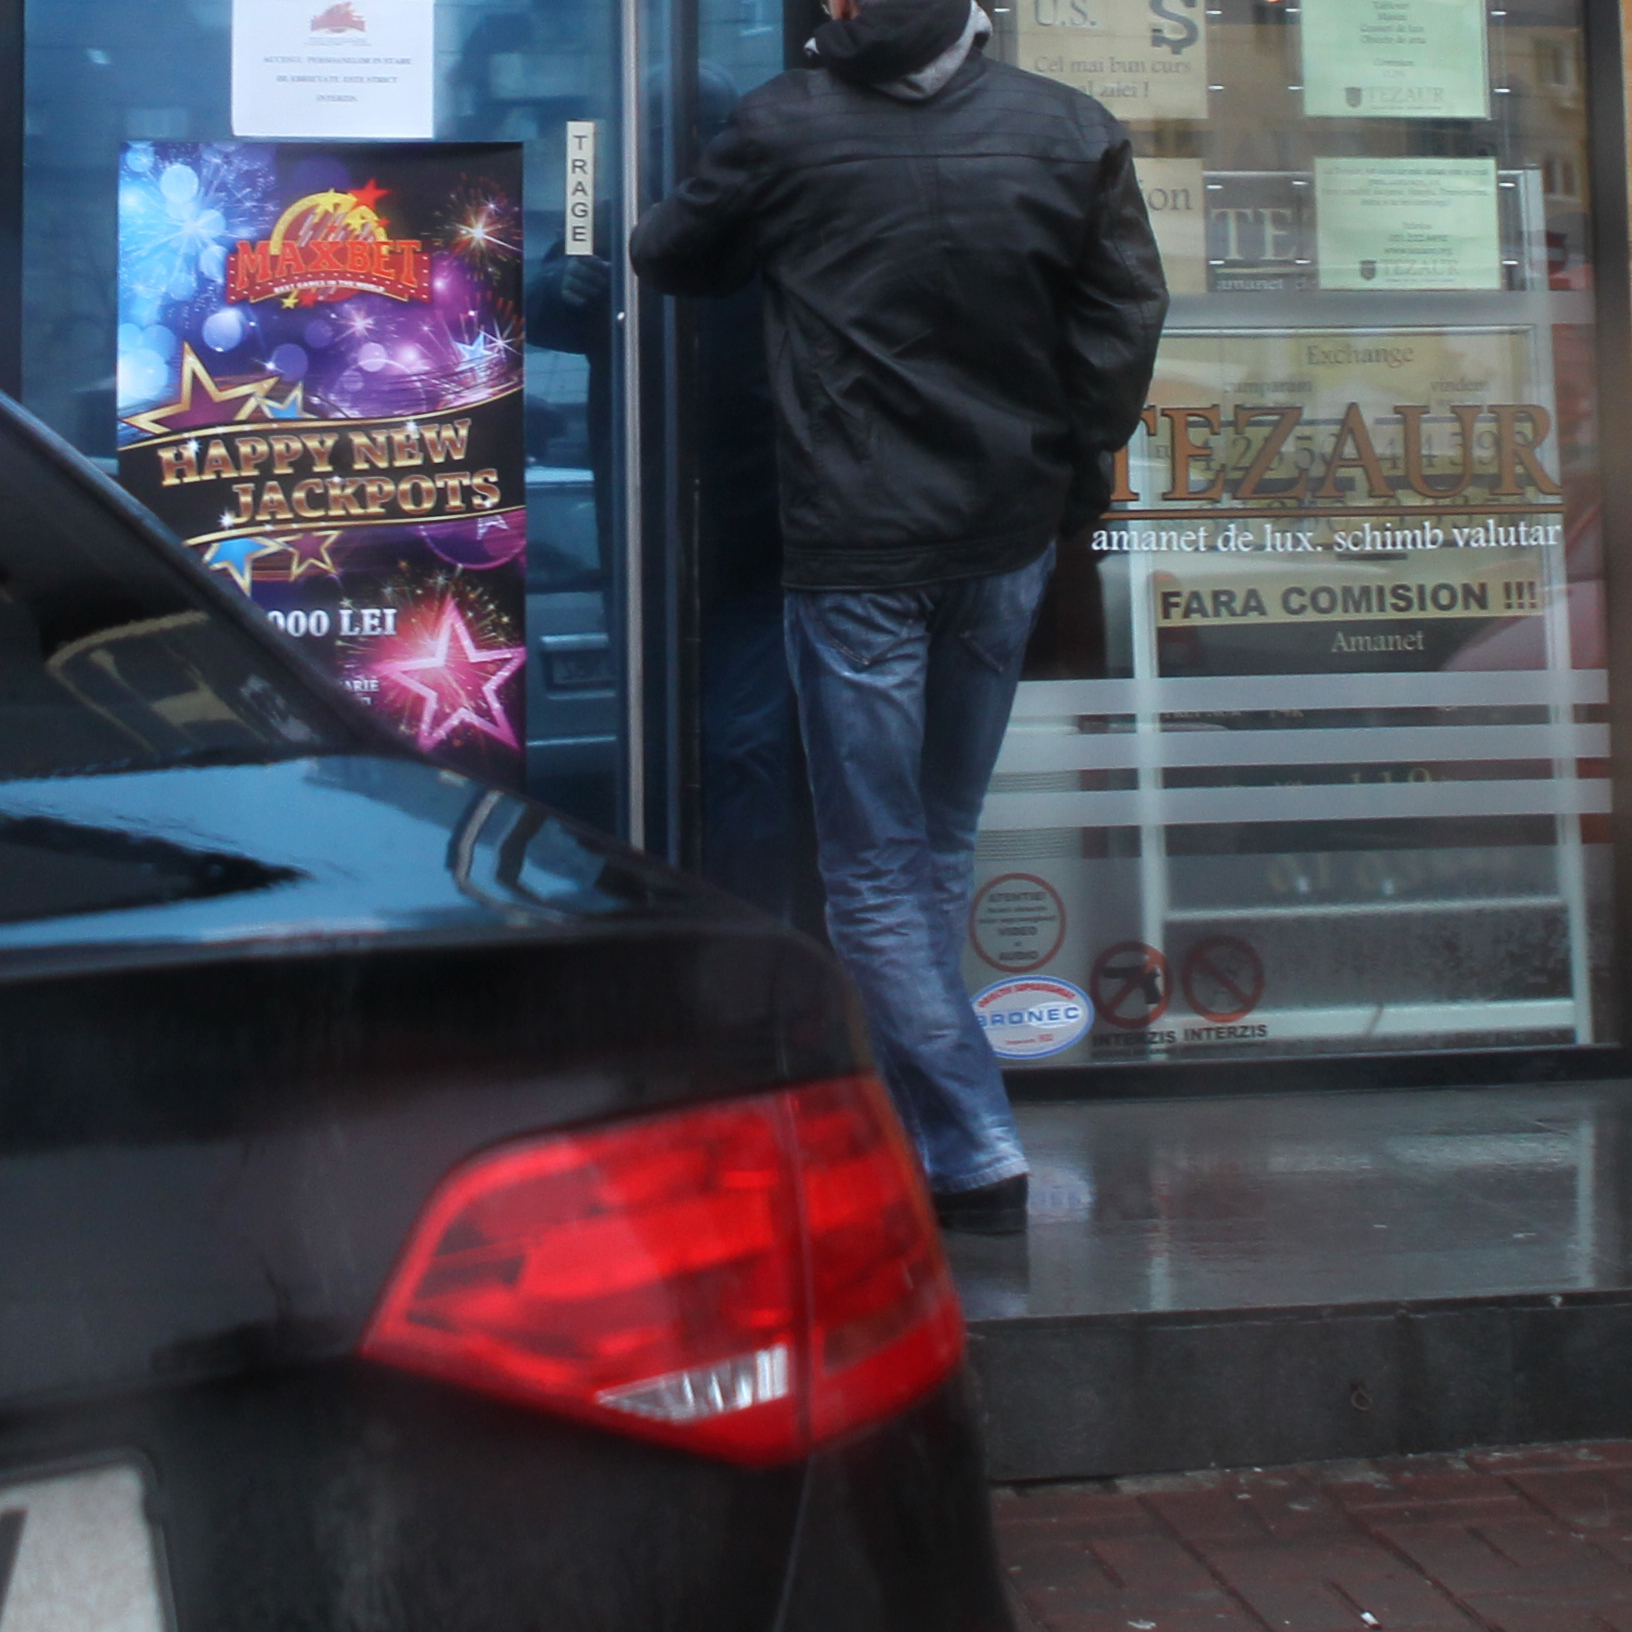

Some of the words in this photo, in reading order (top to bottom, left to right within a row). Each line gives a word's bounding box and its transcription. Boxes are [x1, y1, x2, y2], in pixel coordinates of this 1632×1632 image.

[1070, 56, 1104, 74] mai
[1109, 55, 1146, 74] bun
[1151, 58, 1191, 74] curs
[1369, 86, 1445, 103] TEZAUR
[571, 134, 588, 242] TRAGE
[236, 239, 422, 291] MAXBET
[1307, 344, 1414, 368] Exchange
[157, 426, 339, 487] HAPPY
[348, 419, 473, 475] NEW
[1111, 402, 1564, 503] TEZAUR
[228, 468, 501, 526] JACKPOTS
[1091, 525, 1208, 553] amanet
[1216, 523, 1255, 552] de
[1264, 522, 1324, 553] lux.
[1333, 520, 1444, 553] schimb
[1451, 518, 1564, 549] valutar
[1161, 587, 1266, 619] FARA
[1282, 582, 1489, 615] COMISION
[1504, 579, 1538, 610] !!!
[338, 608, 398, 636] LEI
[1331, 630, 1425, 654] Amanet
[1092, 1030, 1177, 1049] INTERZIS
[1183, 1023, 1268, 1042] INTERZIS
